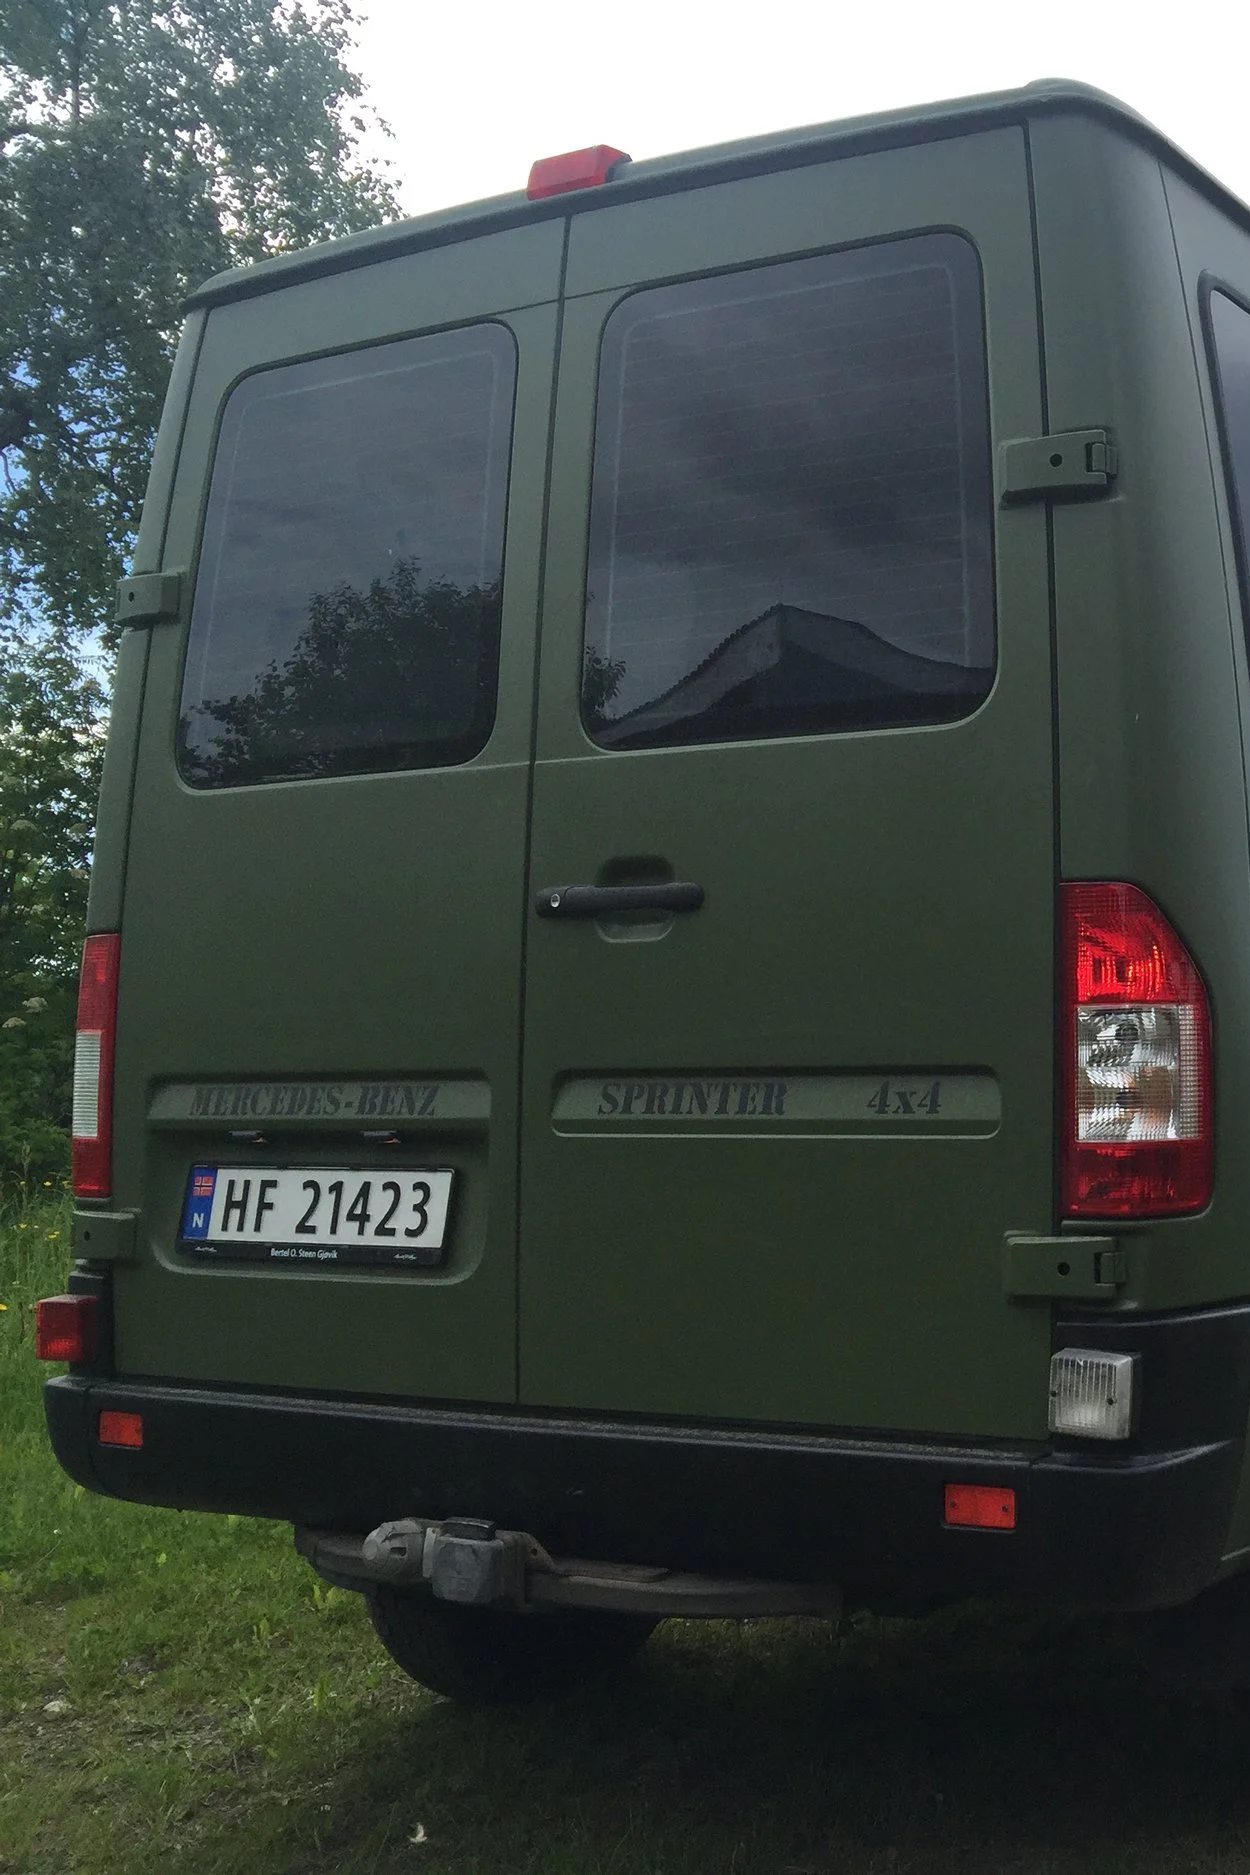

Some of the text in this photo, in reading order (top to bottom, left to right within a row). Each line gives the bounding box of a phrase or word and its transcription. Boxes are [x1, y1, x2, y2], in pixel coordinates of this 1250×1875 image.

[598, 1079, 943, 1115] SPRINTER 4x4
[192, 1213, 204, 1229] N
[221, 1179, 431, 1238] HF 21423
[298, 1249, 317, 1258] Steen
